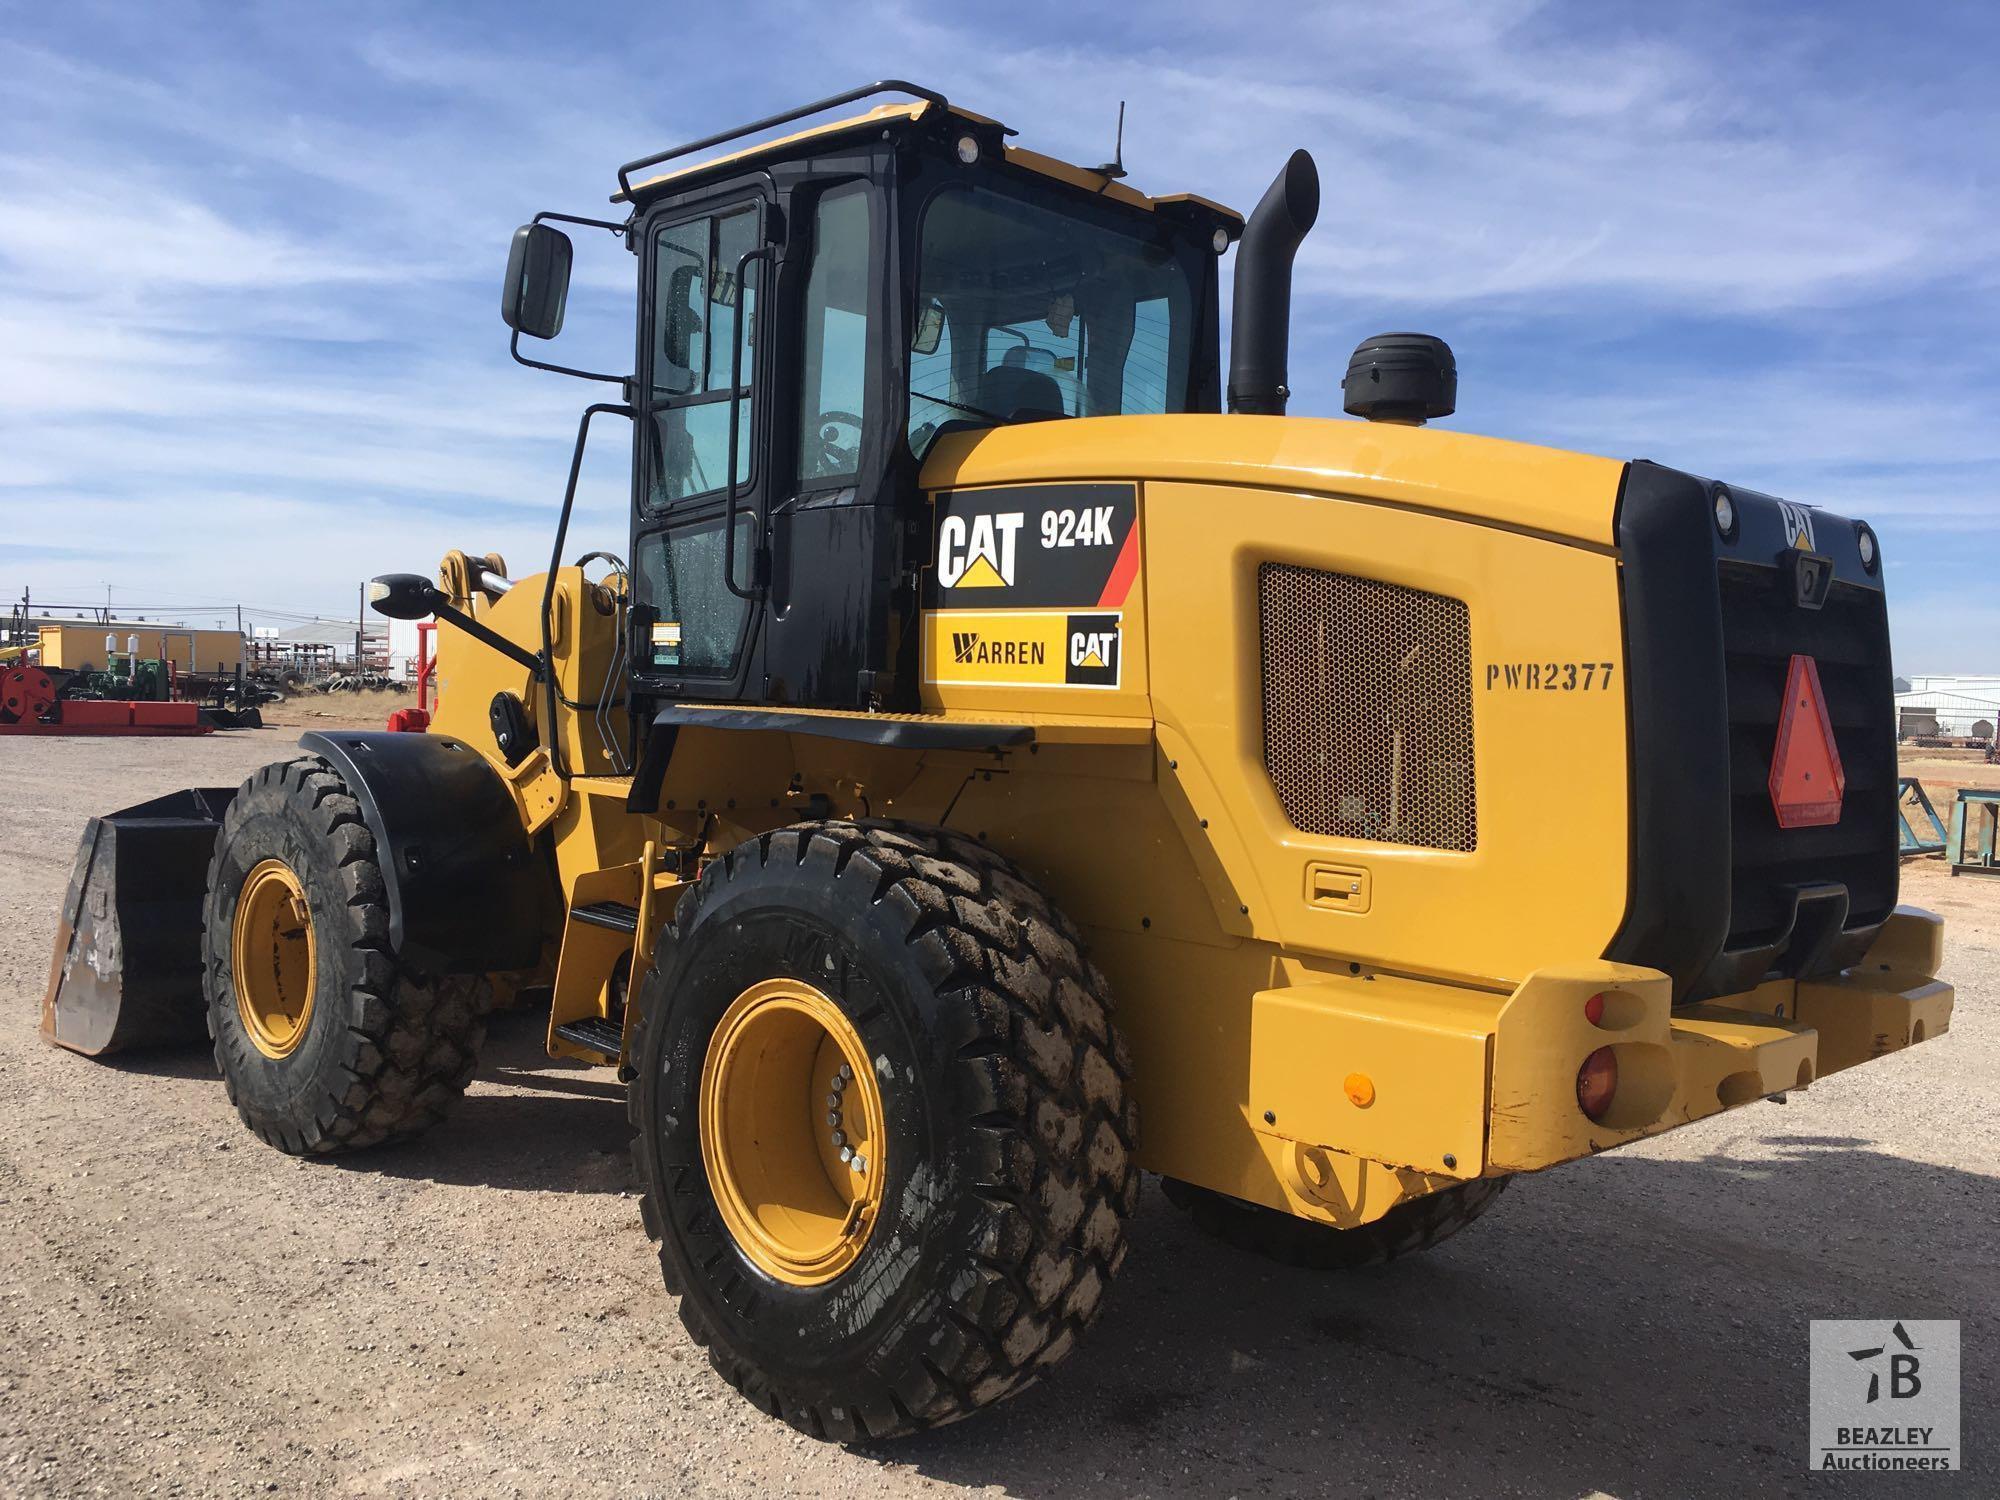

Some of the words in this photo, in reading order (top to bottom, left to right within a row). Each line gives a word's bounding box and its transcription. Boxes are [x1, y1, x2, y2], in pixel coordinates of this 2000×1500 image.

[938, 512, 1024, 588] CAT
[1040, 506, 1114, 549] 924K
[1777, 501, 1817, 553] CAT
[952, 632, 1045, 665] WARREN
[1071, 632, 1114, 667] CAT
[1486, 663, 1614, 691] PWR2377
